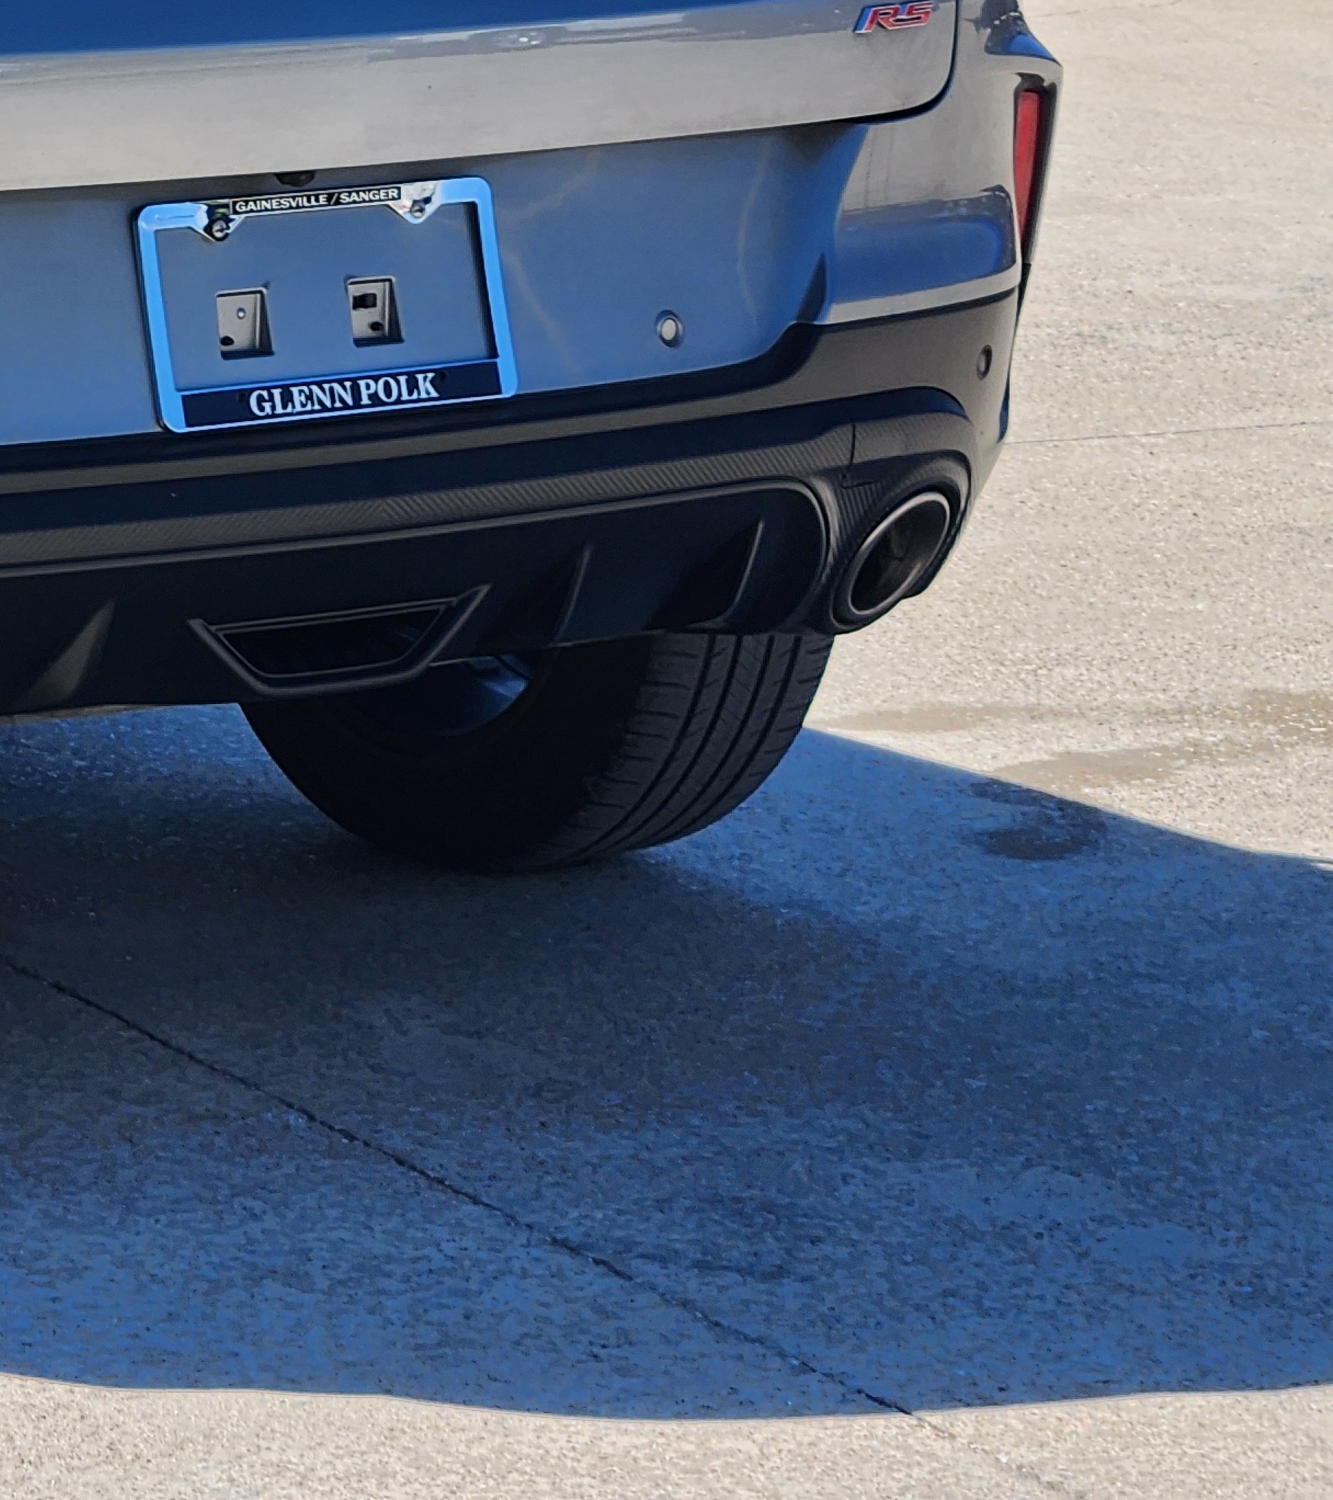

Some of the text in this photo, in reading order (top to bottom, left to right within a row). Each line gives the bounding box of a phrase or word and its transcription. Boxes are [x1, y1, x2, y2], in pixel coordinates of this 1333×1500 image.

[853, 0, 935, 34] RS
[234, 194, 328, 213] GAINESVILLE
[339, 187, 400, 204] SANGER
[248, 372, 440, 417] GLENN POLK
